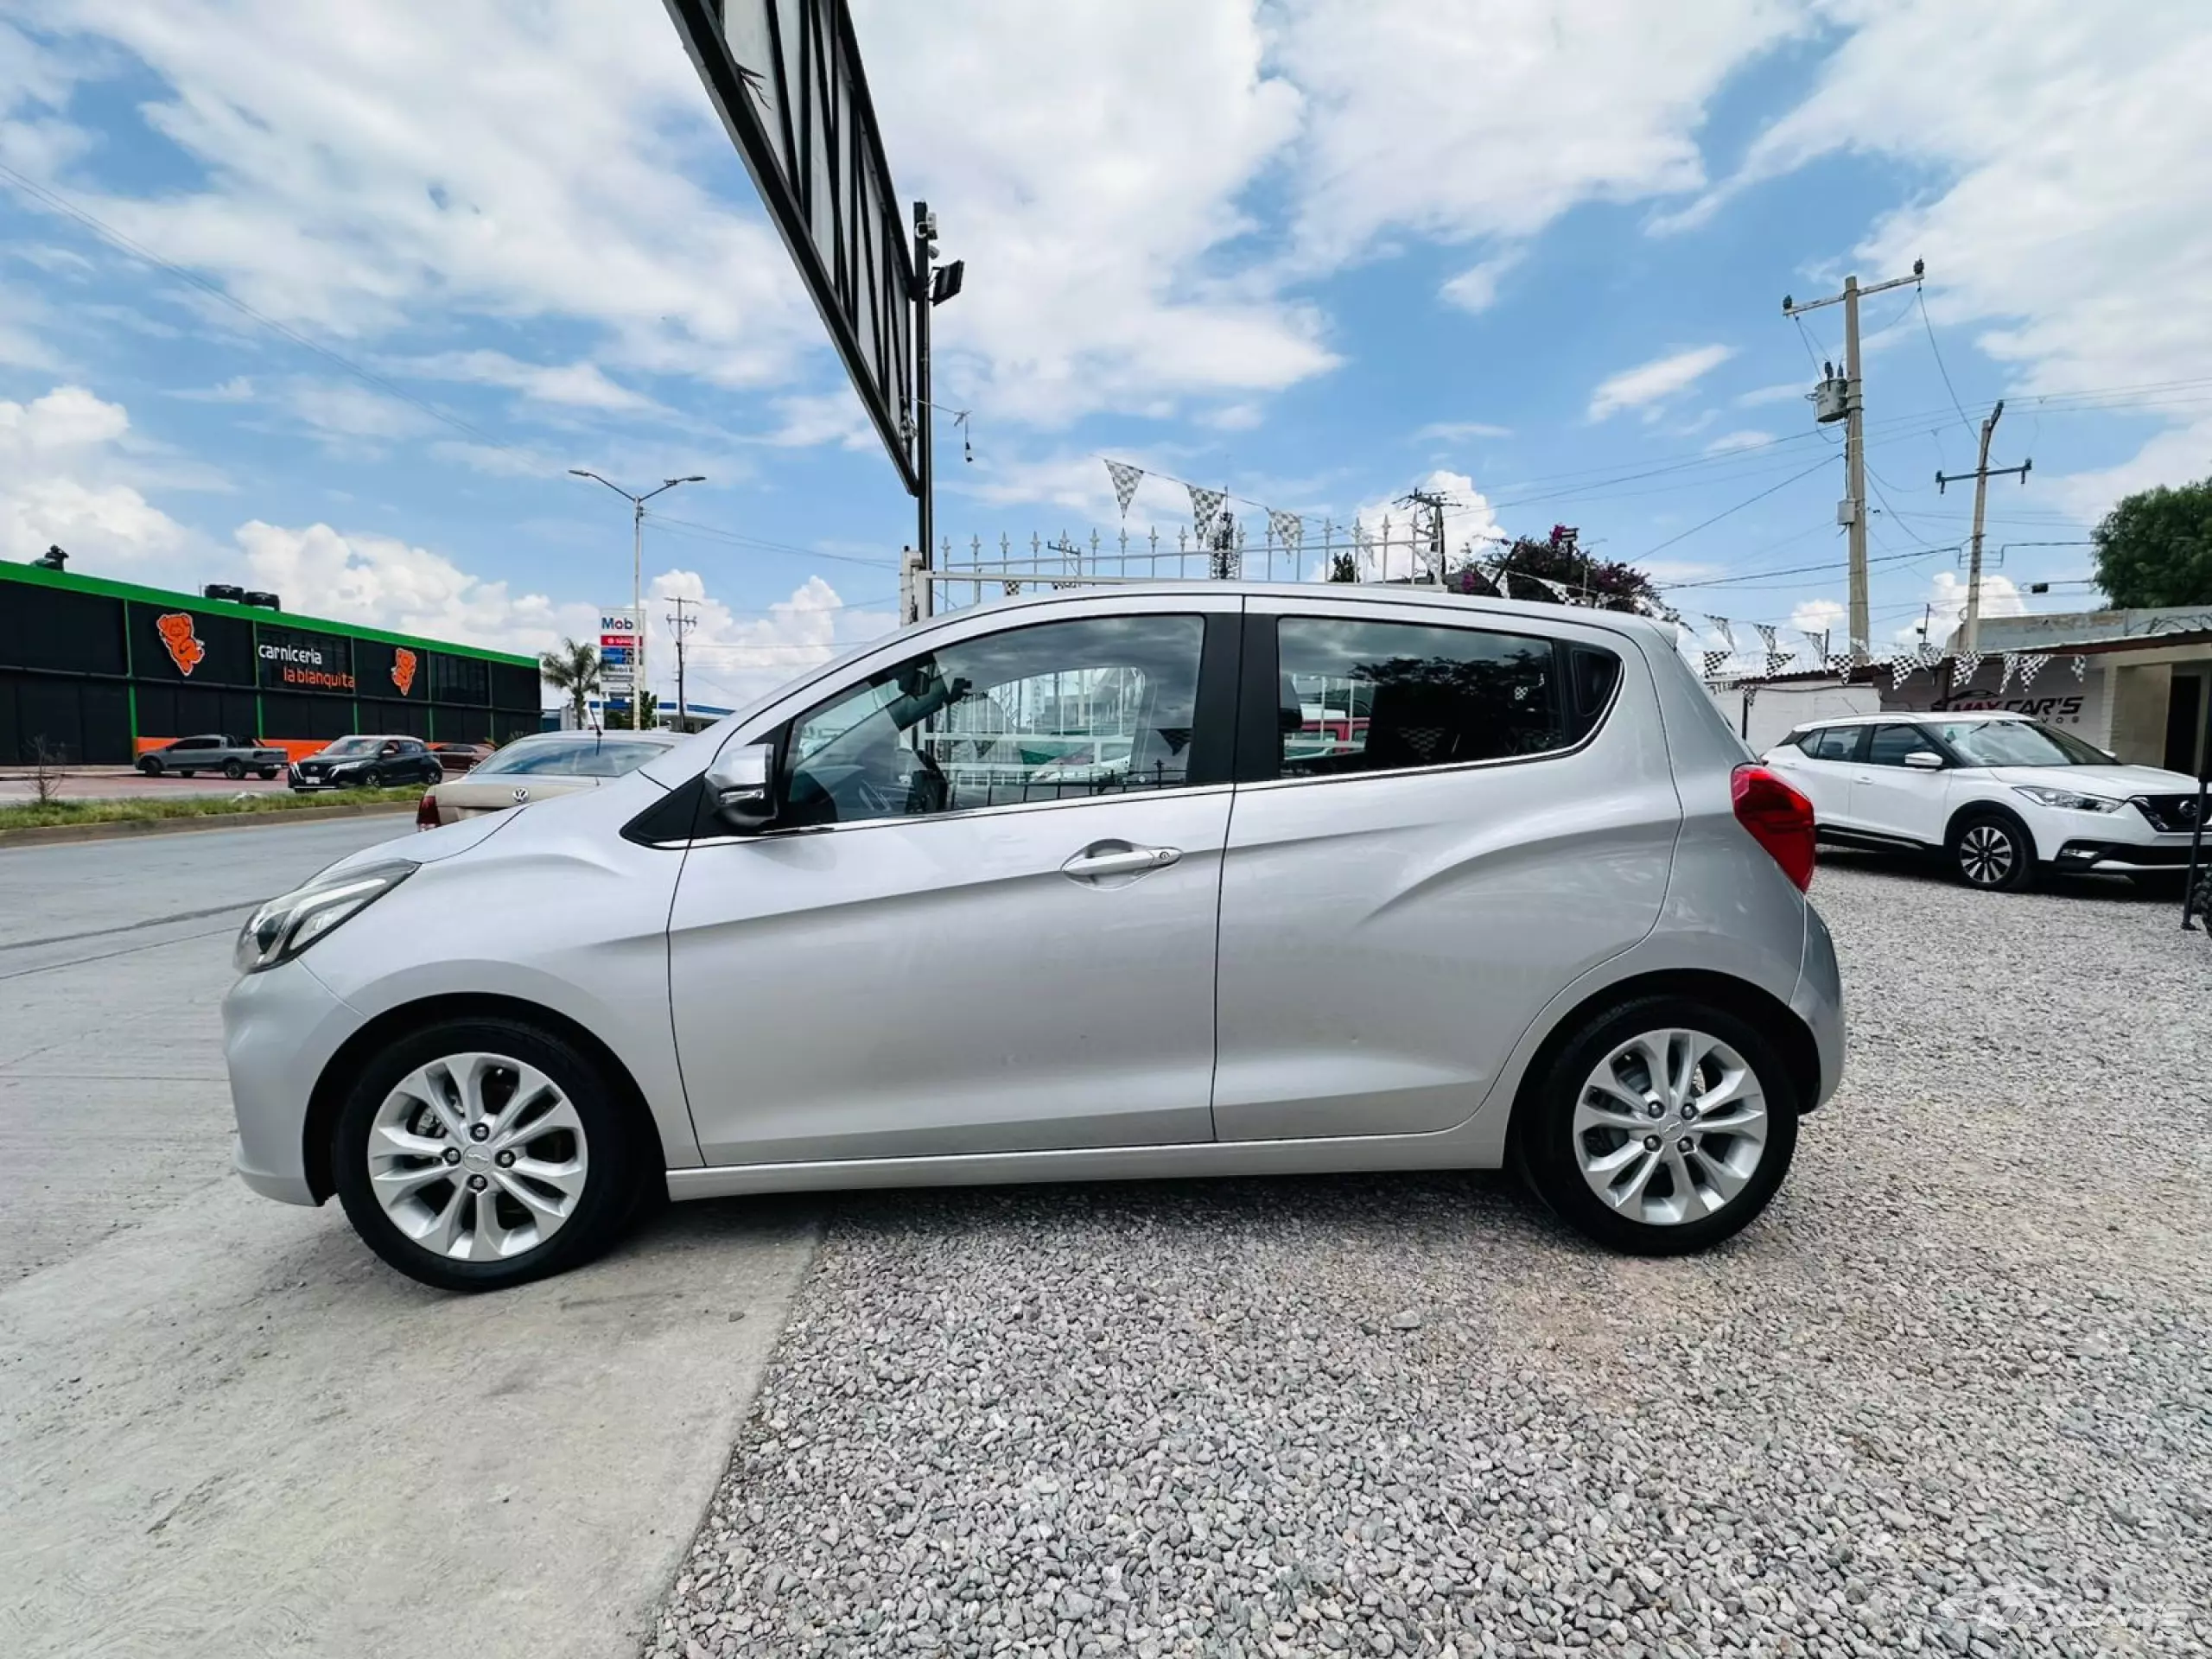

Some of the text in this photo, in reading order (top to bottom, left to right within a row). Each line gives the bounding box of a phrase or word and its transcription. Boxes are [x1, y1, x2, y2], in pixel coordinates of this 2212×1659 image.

[601, 617, 636, 630] Mob
[258, 645, 322, 664] carniceria
[283, 666, 355, 690] la blanquita
